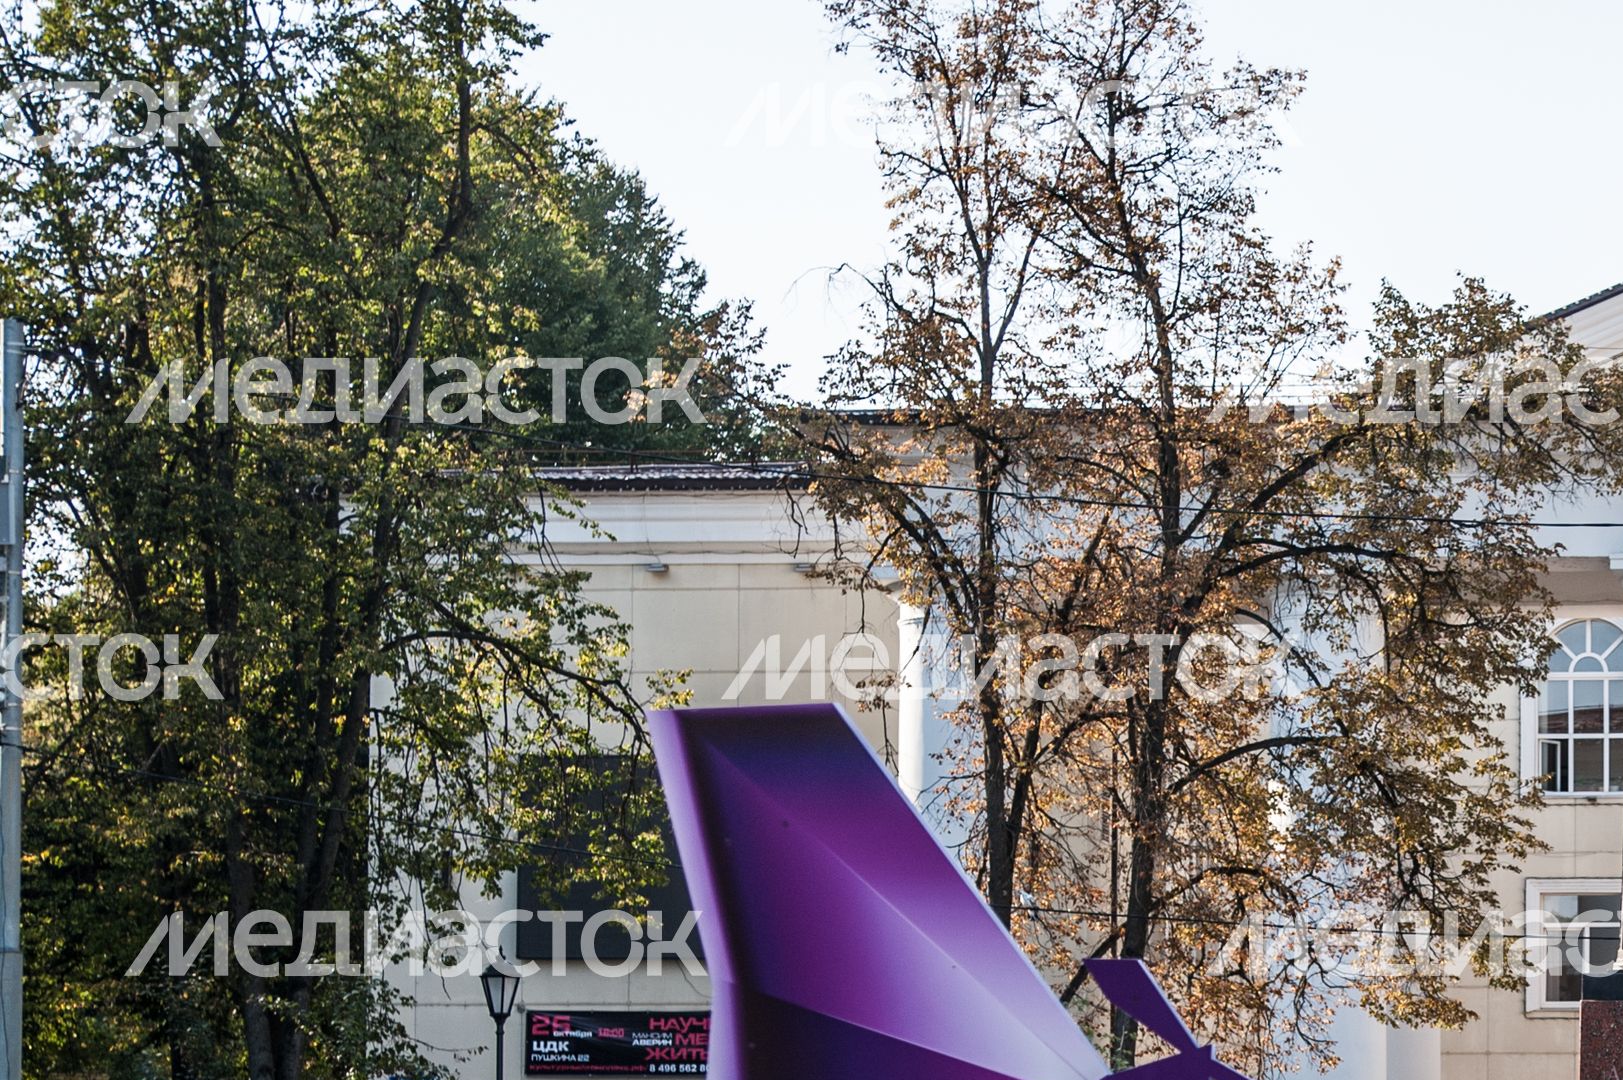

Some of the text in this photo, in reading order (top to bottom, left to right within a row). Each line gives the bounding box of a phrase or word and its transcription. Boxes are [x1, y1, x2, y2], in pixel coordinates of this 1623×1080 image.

[649, 1016, 711, 1032] НАУЧ
[532, 1041, 570, 1053] ЦДК
[531, 1054, 577, 1062] ПУШКИНА
[649, 1064, 656, 1073] 8
[657, 1064, 677, 1073] 496
[678, 1064, 698, 1073] 562
